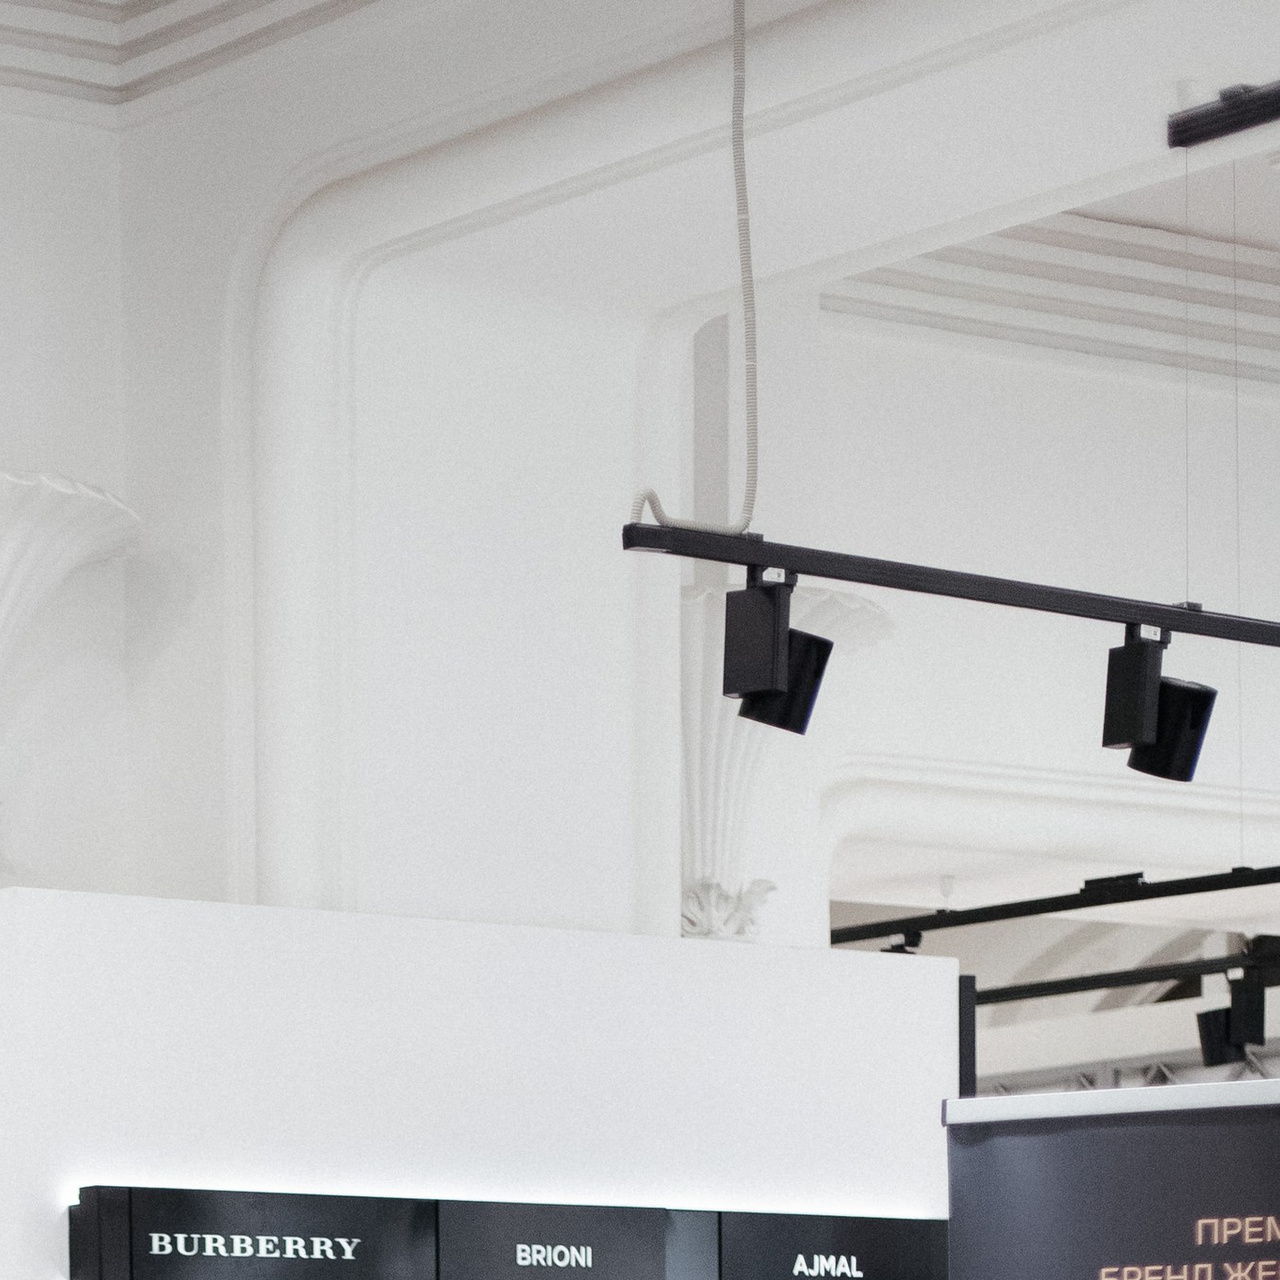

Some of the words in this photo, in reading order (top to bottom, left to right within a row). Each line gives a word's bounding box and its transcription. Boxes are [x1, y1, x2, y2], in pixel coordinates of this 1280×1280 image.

[148, 1233, 362, 1261] BURBERRY
[515, 1244, 593, 1268] BRIONI
[793, 1255, 863, 1279] AJMAL
